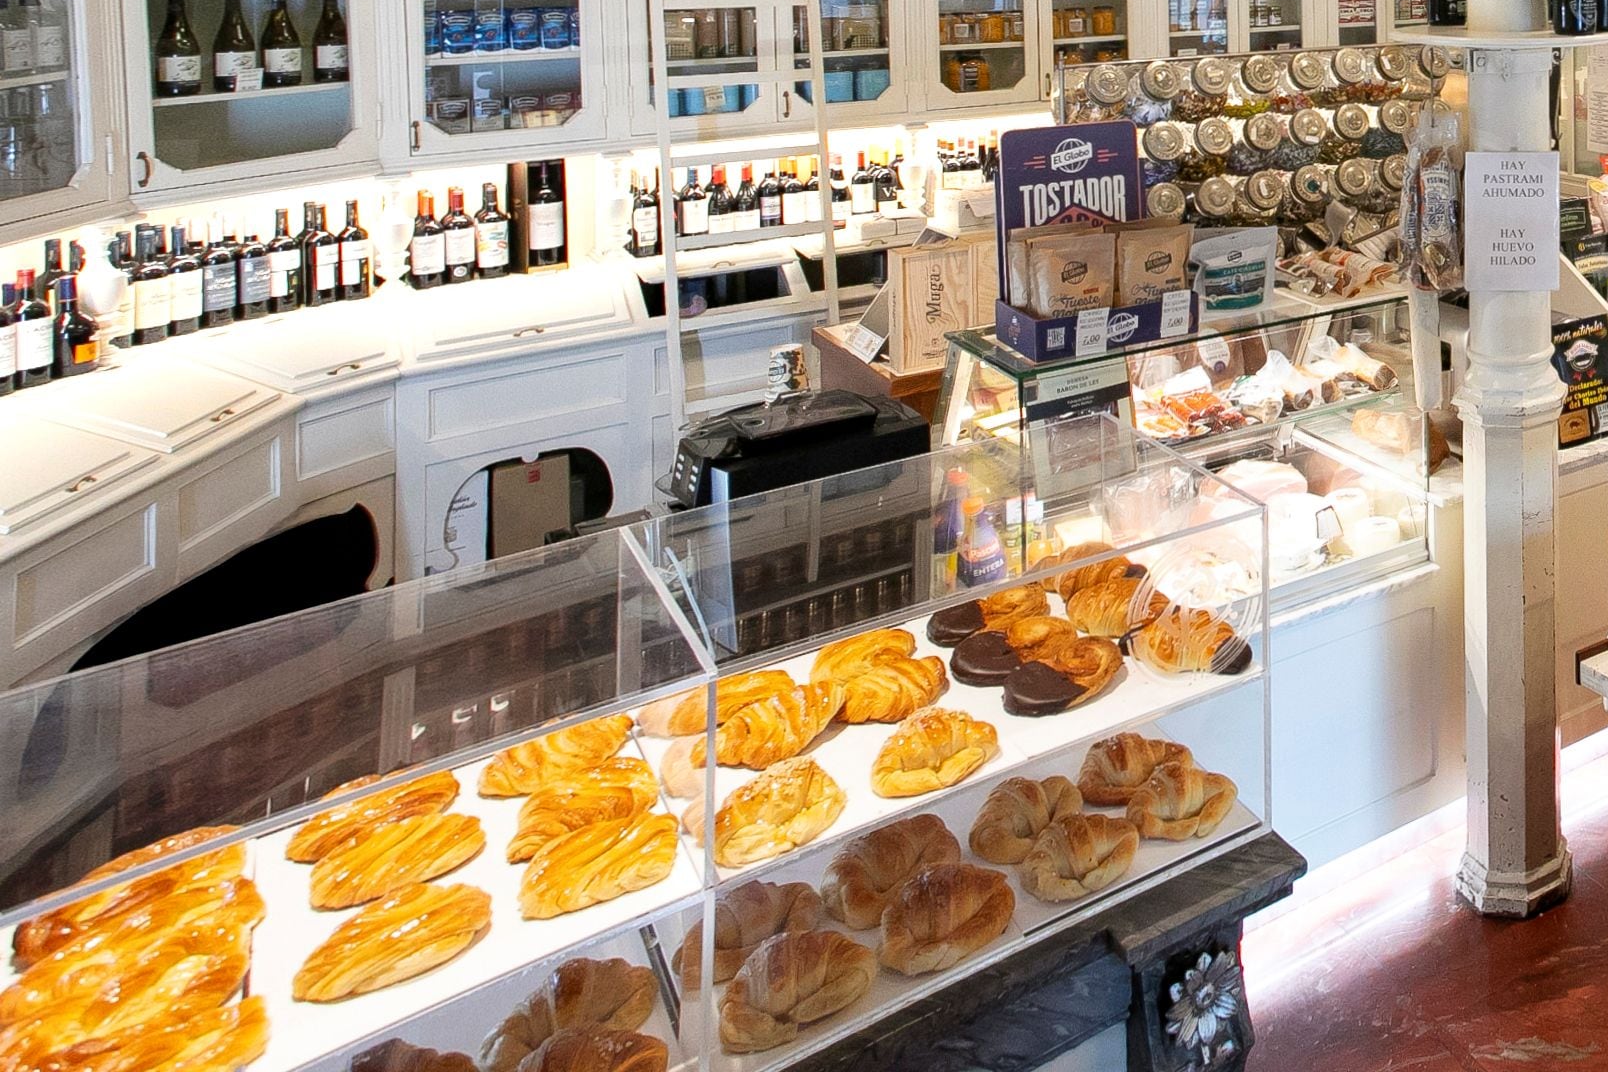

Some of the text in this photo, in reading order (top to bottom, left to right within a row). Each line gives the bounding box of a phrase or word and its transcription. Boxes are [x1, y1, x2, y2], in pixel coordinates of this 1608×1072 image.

[1053, 148, 1091, 165] El Globo
[1501, 160, 1526, 170] HAY
[1483, 174, 1544, 184] PASTRAMI
[1482, 188, 1545, 198] AHUMADO
[1019, 174, 1127, 228] TOSTADOR
[1500, 229, 1526, 239] HAY
[1492, 242, 1534, 252] HUEVO
[1490, 256, 1536, 266] HILADO
[926, 264, 944, 324] Muga
[1061, 295, 1101, 308] Tueste
[1115, 320, 1135, 331] Globo
[1082, 334, 1101, 346] 7,00
[1056, 383, 1078, 394] BARON
[1569, 393, 1608, 410] del Mundo
[973, 558, 1005, 577] ENTERA
